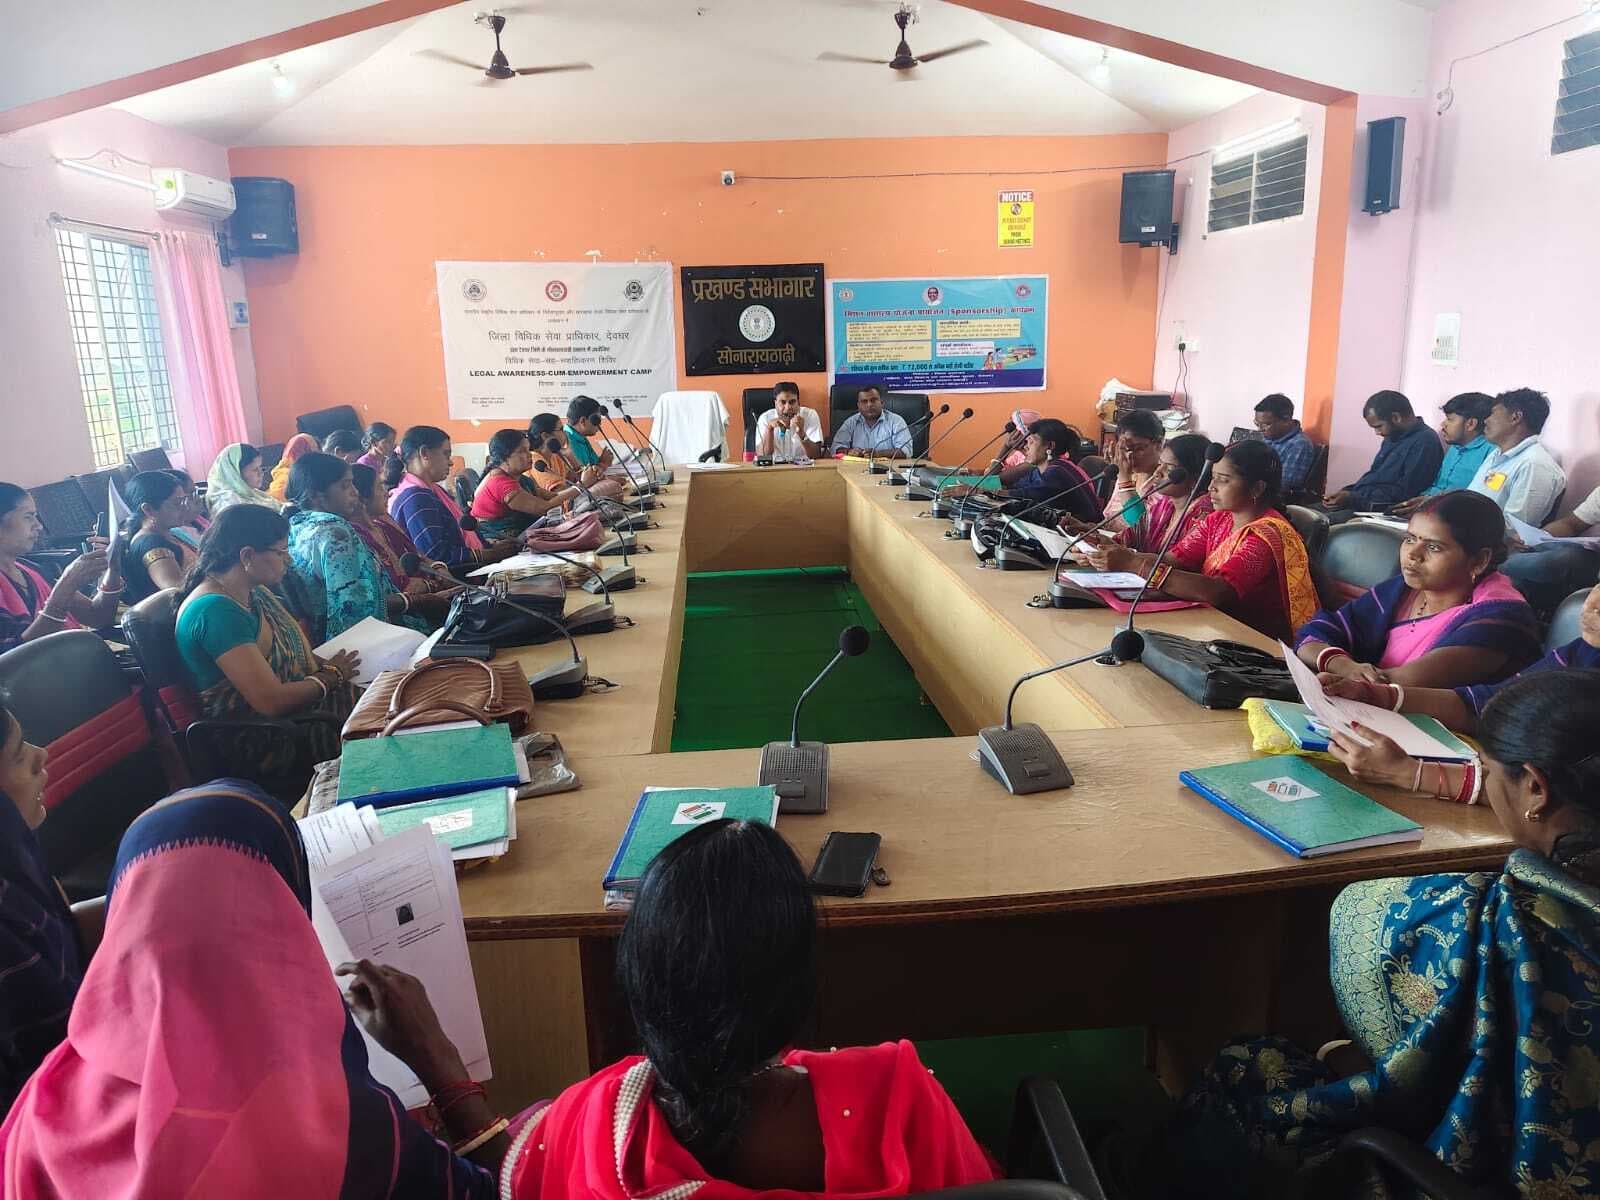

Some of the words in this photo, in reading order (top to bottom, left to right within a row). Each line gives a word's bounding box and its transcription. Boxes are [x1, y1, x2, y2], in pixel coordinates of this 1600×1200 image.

[1001, 191, 1033, 202] NOTICE
[690, 278, 746, 304] प्रखण्ड
[747, 276, 816, 299] सभागार
[488, 330, 511, 341] जिला
[514, 330, 541, 341] विधिक
[545, 330, 561, 341] सेवा
[606, 329, 630, 341] देवघर
